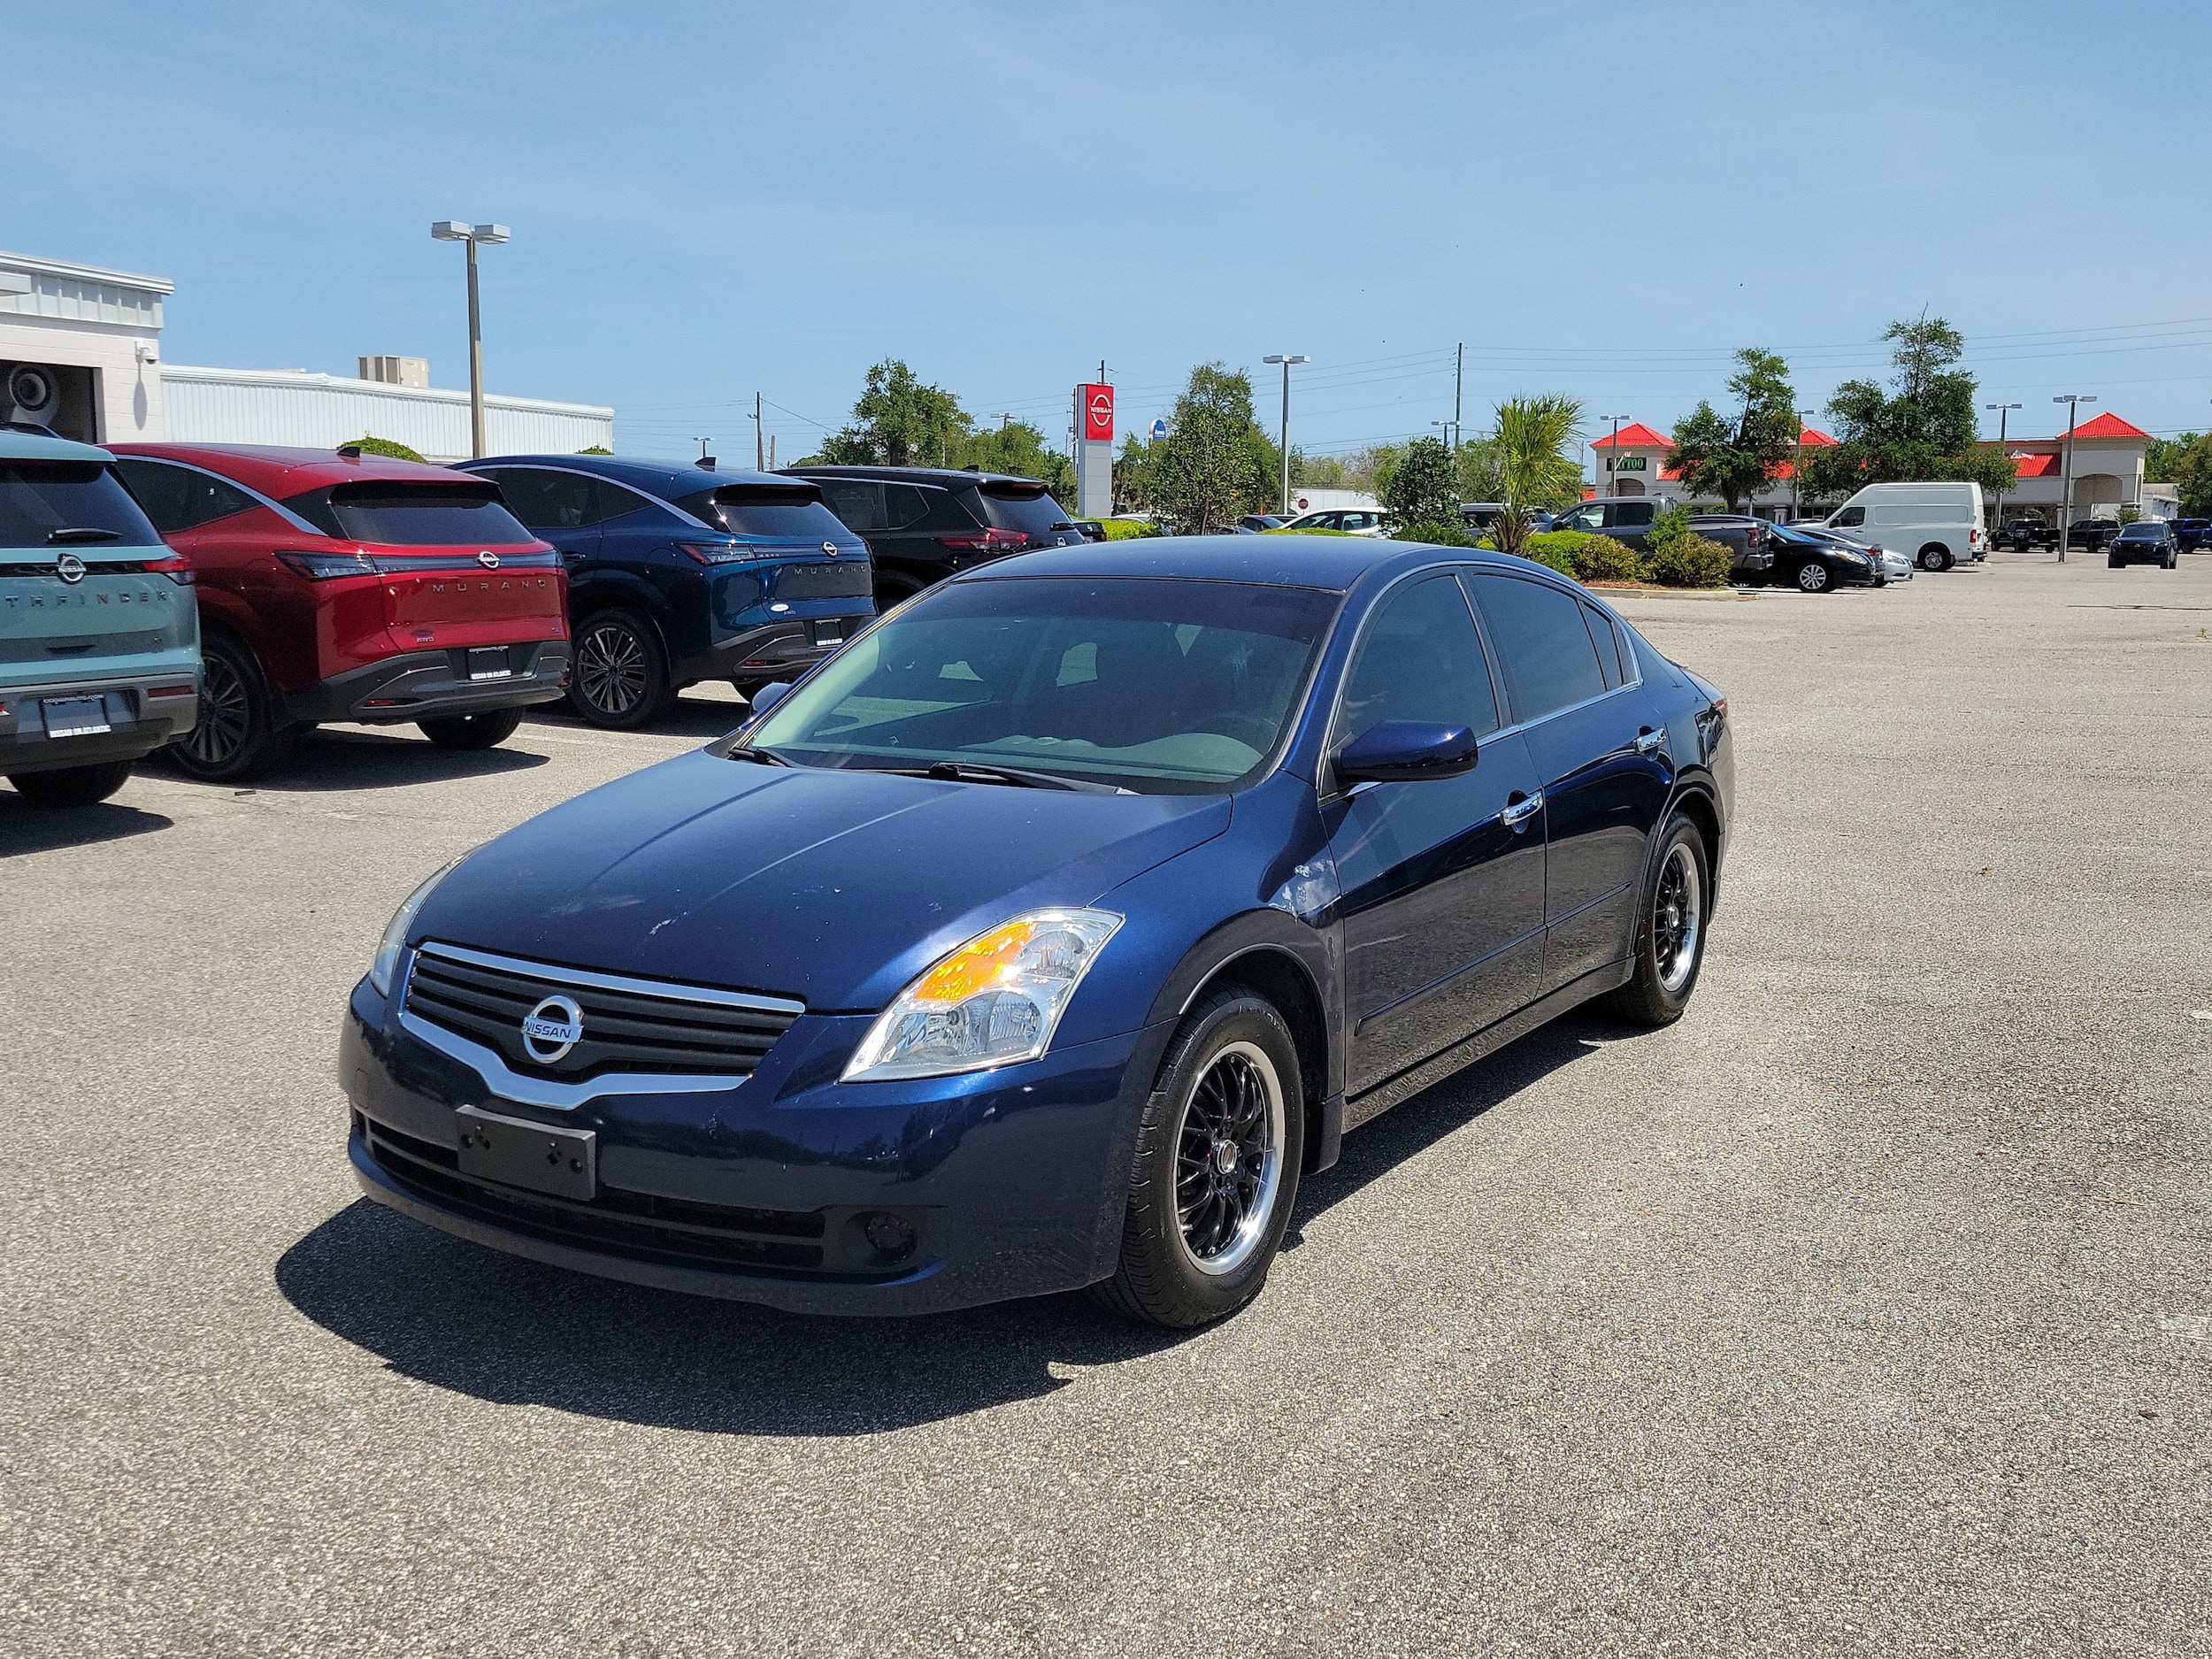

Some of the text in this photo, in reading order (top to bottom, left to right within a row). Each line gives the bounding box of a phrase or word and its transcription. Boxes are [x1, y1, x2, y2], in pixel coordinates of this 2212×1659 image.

[1609, 458, 1644, 469] TTOO
[793, 565, 867, 575] MURANO
[432, 580, 546, 593] MURANO
[524, 1020, 572, 1039] NISSAN
